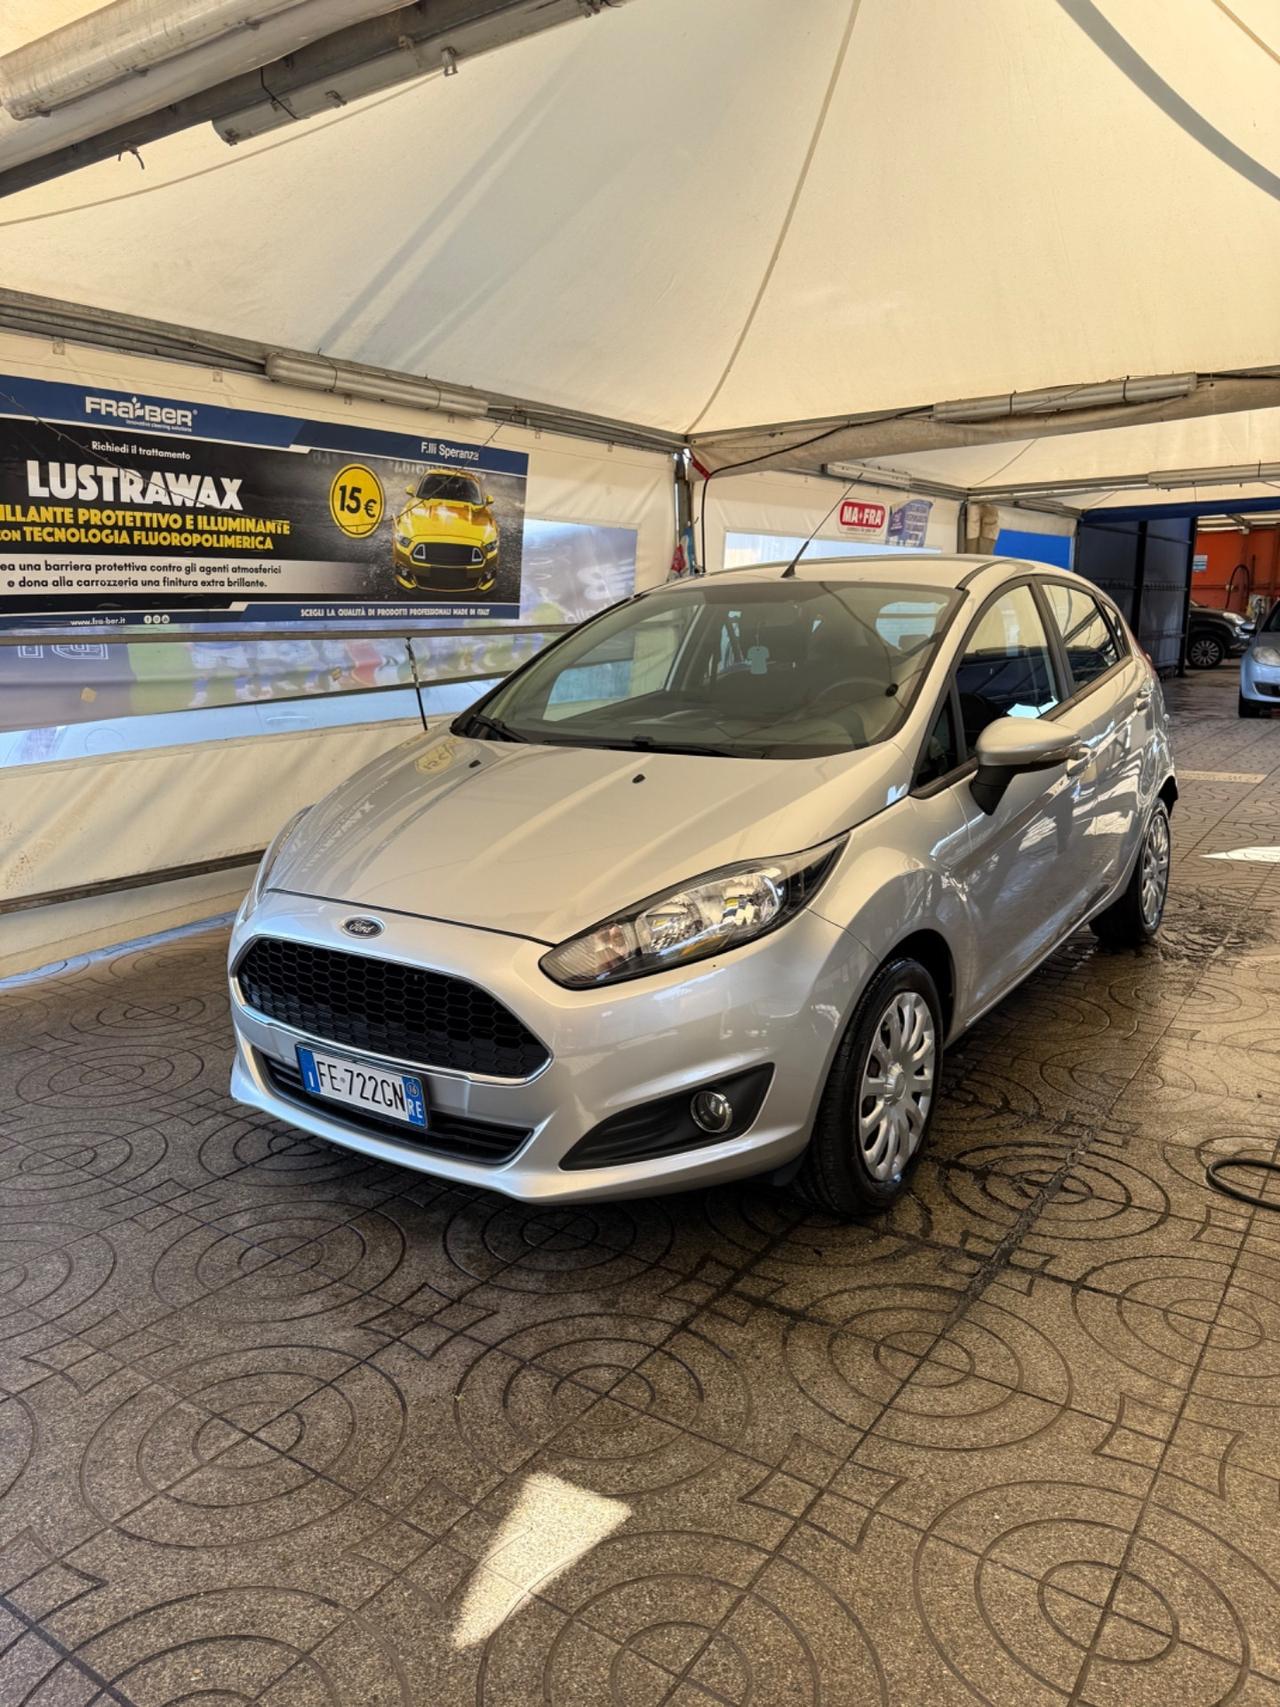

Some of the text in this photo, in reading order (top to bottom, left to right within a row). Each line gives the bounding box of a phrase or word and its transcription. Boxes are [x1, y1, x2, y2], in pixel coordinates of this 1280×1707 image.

[91, 440, 191, 460] Richiedi il trattamento
[439, 444, 480, 461] Speranza
[27, 460, 243, 511] LUSTRAWAX
[78, 508, 182, 530] PROTETTIVO
[186, 515, 194, 530] E
[197, 515, 290, 535] ILLUMINANTE
[0, 526, 273, 550] ON TECNOLOGIA FLUOROPOLIMERICA
[19, 563, 41, 571] una
[44, 560, 91, 571] barriera
[95, 561, 147, 574] protettiva
[150, 563, 182, 573] contro
[184, 563, 196, 575] gli
[199, 564, 229, 575] agenti
[231, 564, 281, 574] atmosferici
[19, 576, 48, 587] dona
[52, 576, 73, 587] alla
[77, 577, 138, 587] carrozzeria
[141, 579, 160, 587] una
[163, 576, 198, 587] finitura
[201, 578, 225, 587] extra
[227, 577, 267, 588] brillante.
[70, 616, 126, 625] www.fra-ber.it
[301, 608, 324, 617] SCEGLI
[326, 608, 336, 617] LA
[338, 606, 366, 617] QUALITÀ
[368, 608, 375, 616] DI
[377, 607, 408, 616] PRODOTTI
[409, 607, 451, 616] PROFESSIONALI
[453, 607, 468, 616] MADE
[470, 608, 476, 616] IN
[407, 1099, 423, 1118] RE
